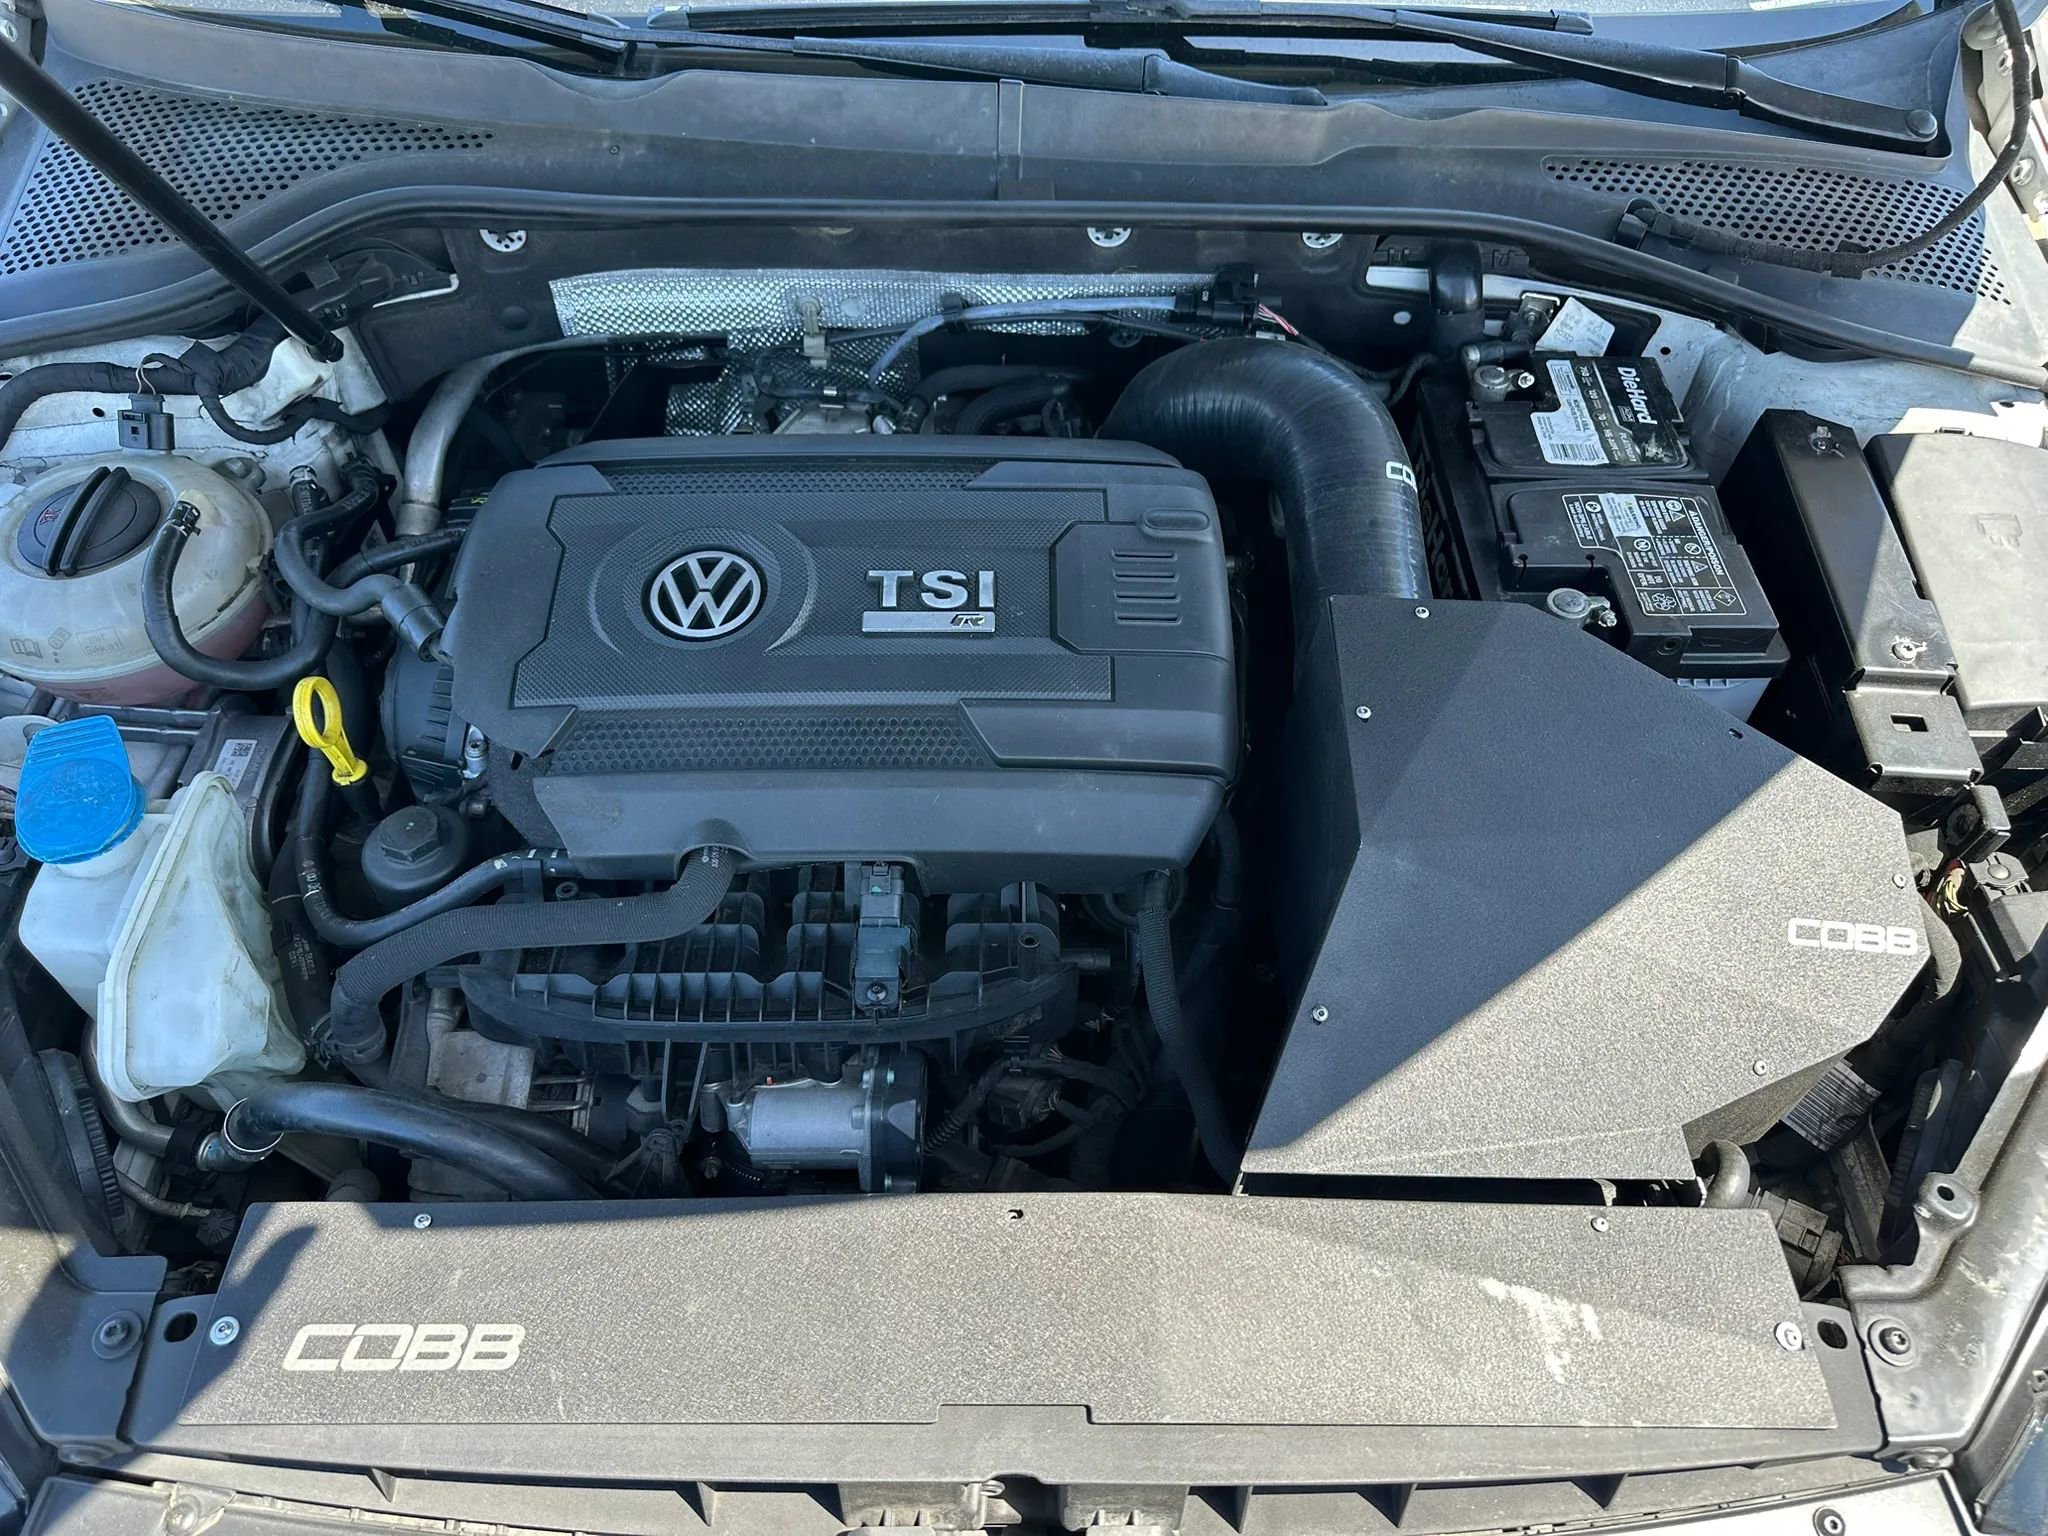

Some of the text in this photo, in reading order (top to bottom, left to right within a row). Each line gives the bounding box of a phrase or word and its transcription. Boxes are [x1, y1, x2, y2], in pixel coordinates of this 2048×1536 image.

[1617, 366, 1658, 425] DieHard
[1386, 461, 1418, 493] CO
[1691, 516, 1724, 575] DANGER/POISON
[868, 570, 994, 608] TSI
[1788, 917, 1919, 955] COBB
[282, 1323, 526, 1371] COBB
